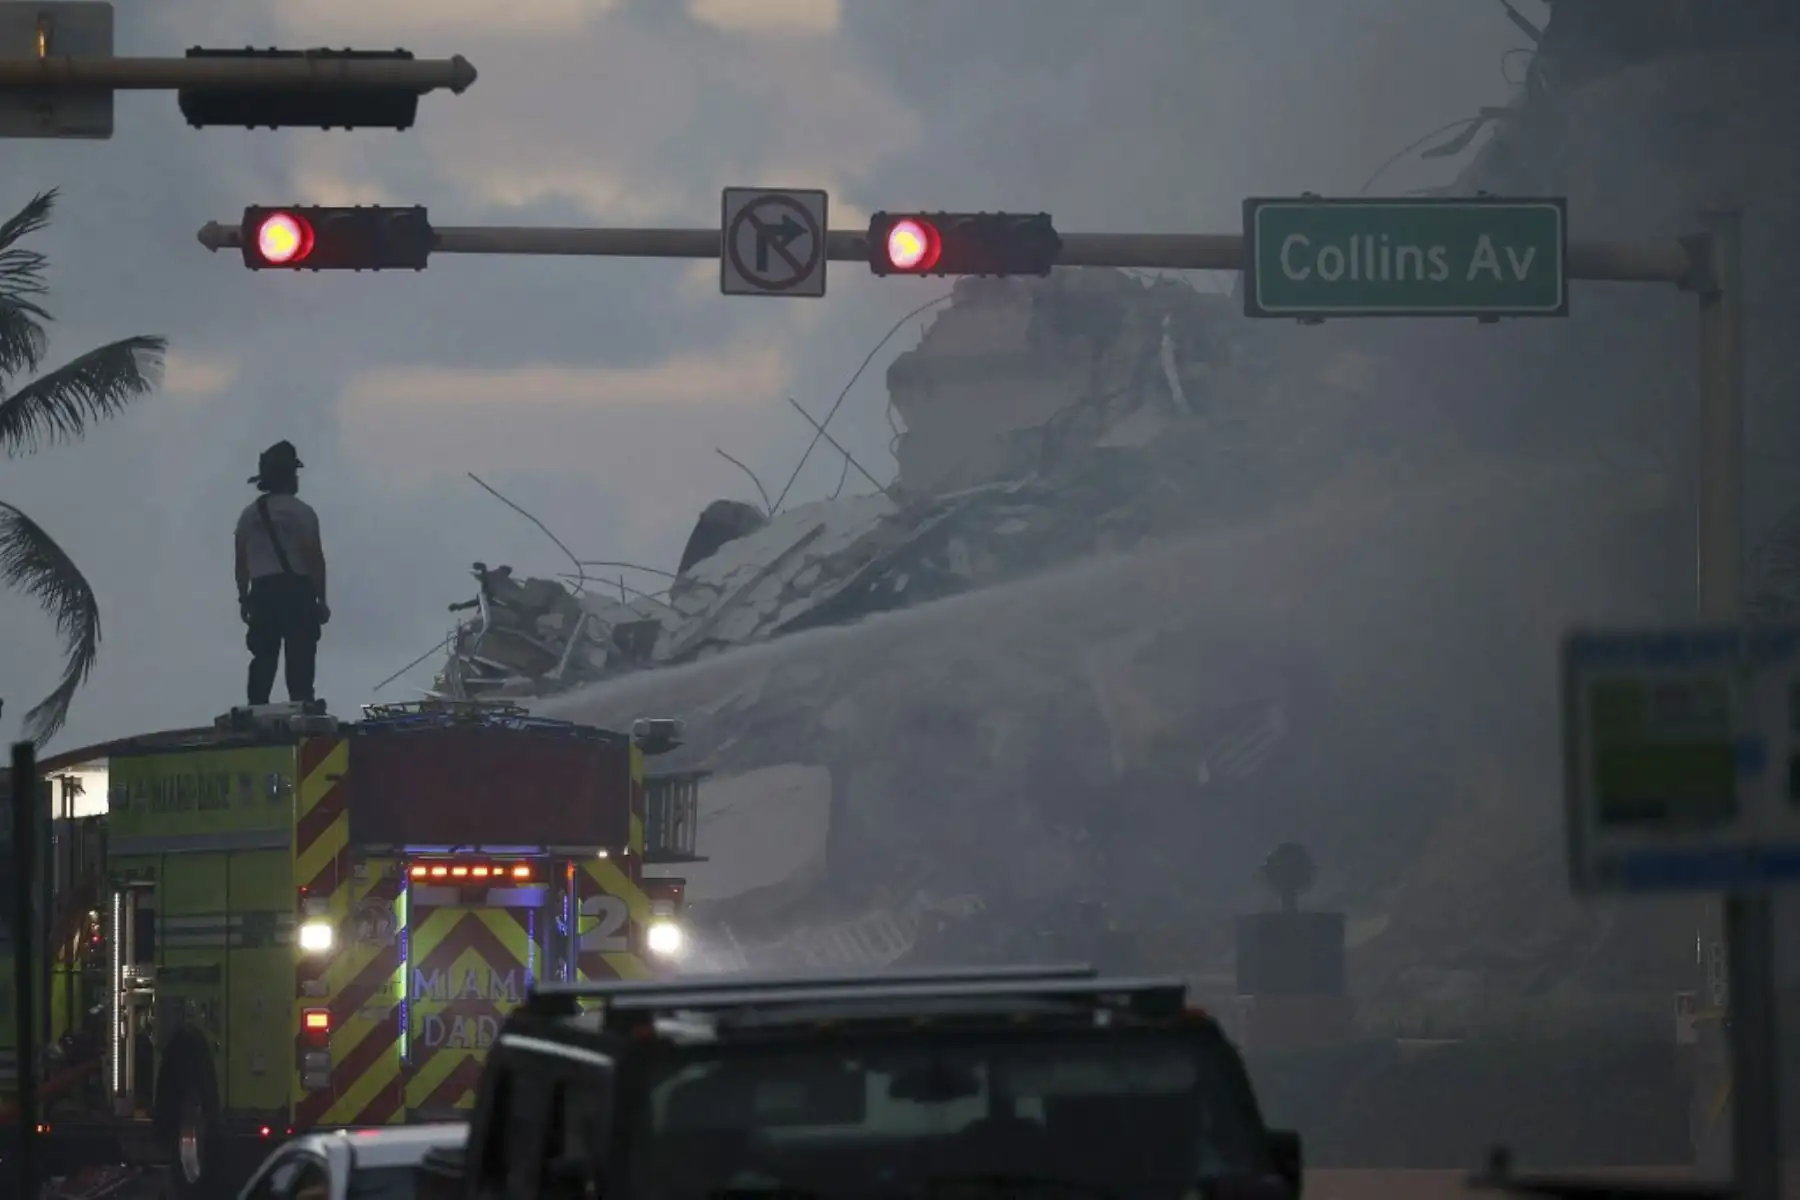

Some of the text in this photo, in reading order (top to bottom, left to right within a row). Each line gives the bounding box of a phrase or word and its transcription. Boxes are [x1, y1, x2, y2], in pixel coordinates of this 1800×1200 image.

[1280, 233, 1536, 282] Collins Av
[579, 894, 628, 951] 2
[424, 1015, 499, 1048] DAD
